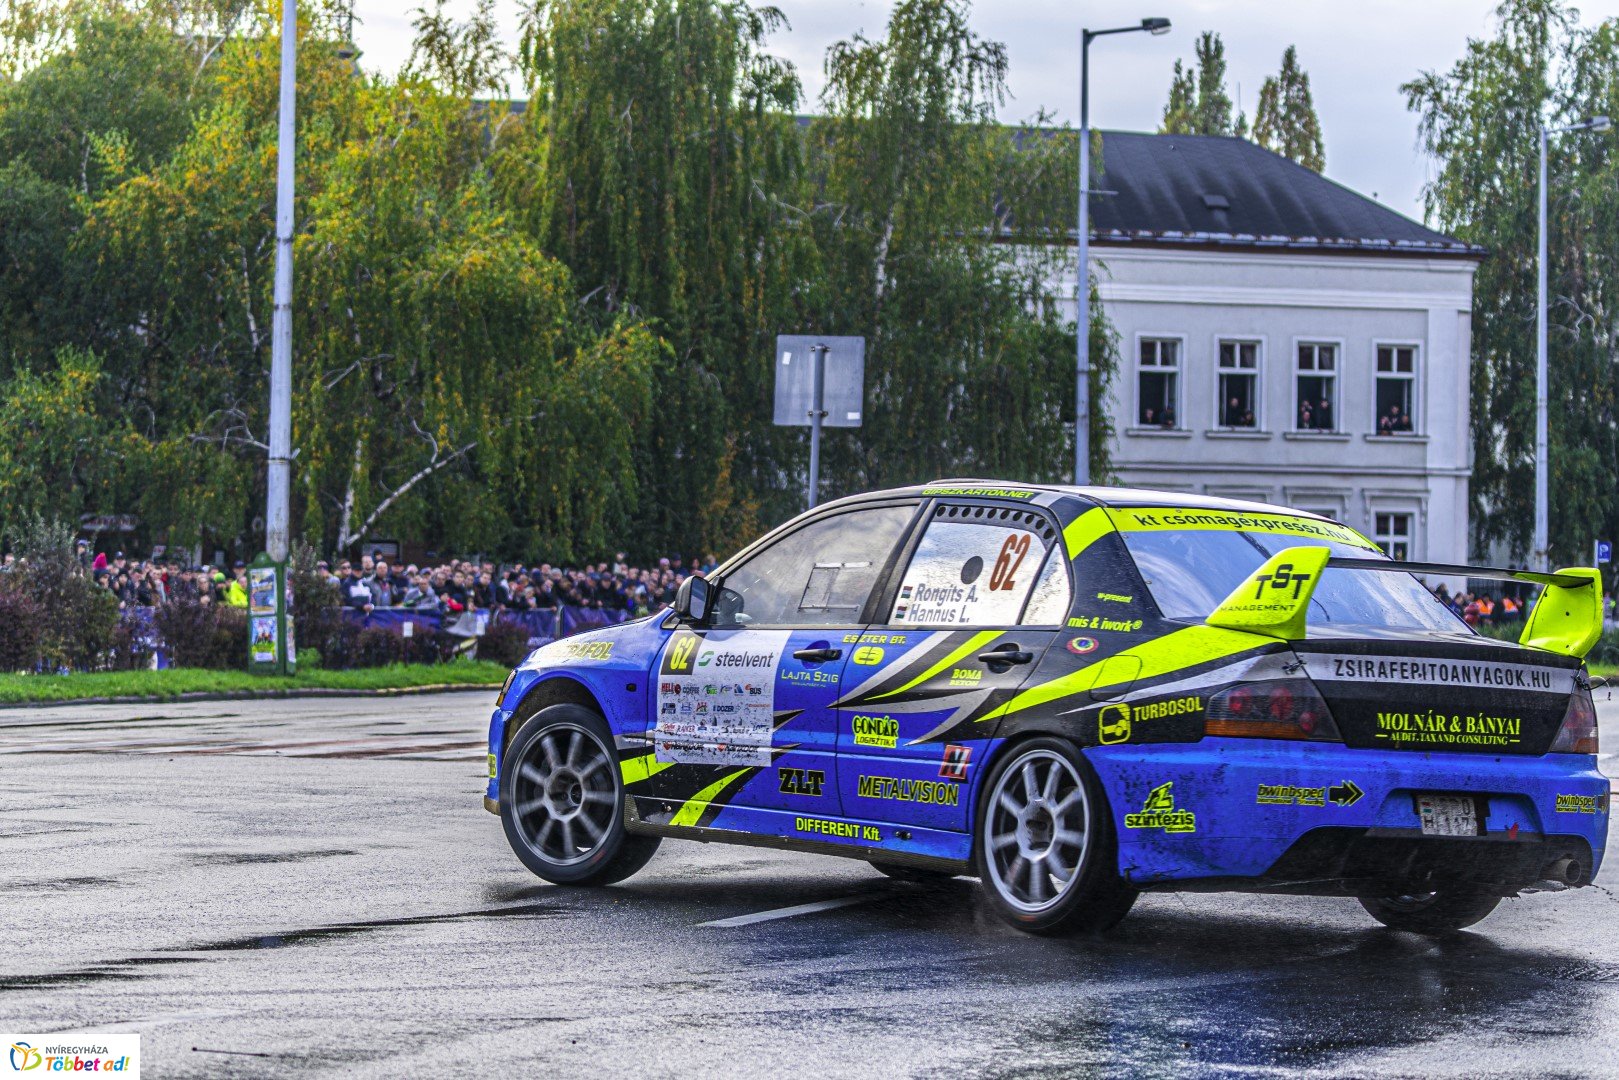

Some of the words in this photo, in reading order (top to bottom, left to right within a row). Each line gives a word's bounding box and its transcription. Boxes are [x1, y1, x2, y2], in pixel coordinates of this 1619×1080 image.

[922, 488, 1034, 498] GIPSZKARTON.NET
[1134, 514, 1158, 527] kt
[1163, 514, 1350, 541] csomagexpressz.hu
[1600, 543, 1609, 558] P
[989, 533, 1031, 591] 62
[1255, 563, 1311, 600] TST
[914, 583, 965, 607] Rongits
[965, 585, 978, 603] A.
[908, 603, 957, 623] Hannus
[959, 605, 970, 623] L.
[1220, 604, 1296, 612] MANAGEMENT
[1067, 615, 1090, 628] mis
[1089, 616, 1100, 629] &
[842, 634, 888, 644] ESZTER
[889, 635, 907, 645] BT.
[670, 636, 695, 670] 62
[715, 651, 774, 668] steelvent
[781, 668, 811, 681] LAJTA
[813, 671, 839, 683] SZIG
[951, 668, 983, 680] BOMA
[1333, 658, 1551, 689] ZSIRAFEPITOANYAGOK.HU
[1133, 697, 1204, 722] TURBOSOL
[852, 715, 899, 738] GONDÁR
[1377, 709, 1447, 732] MOLNÁR
[1449, 715, 1462, 733] &
[1466, 712, 1521, 735] BÁNYAI
[855, 735, 896, 747] LOGISZTIKA
[1456, 734, 1508, 745] CONSULTING
[778, 767, 826, 796] ZLT
[858, 775, 959, 806] METALVISION
[795, 817, 861, 838] DIFFERENT
